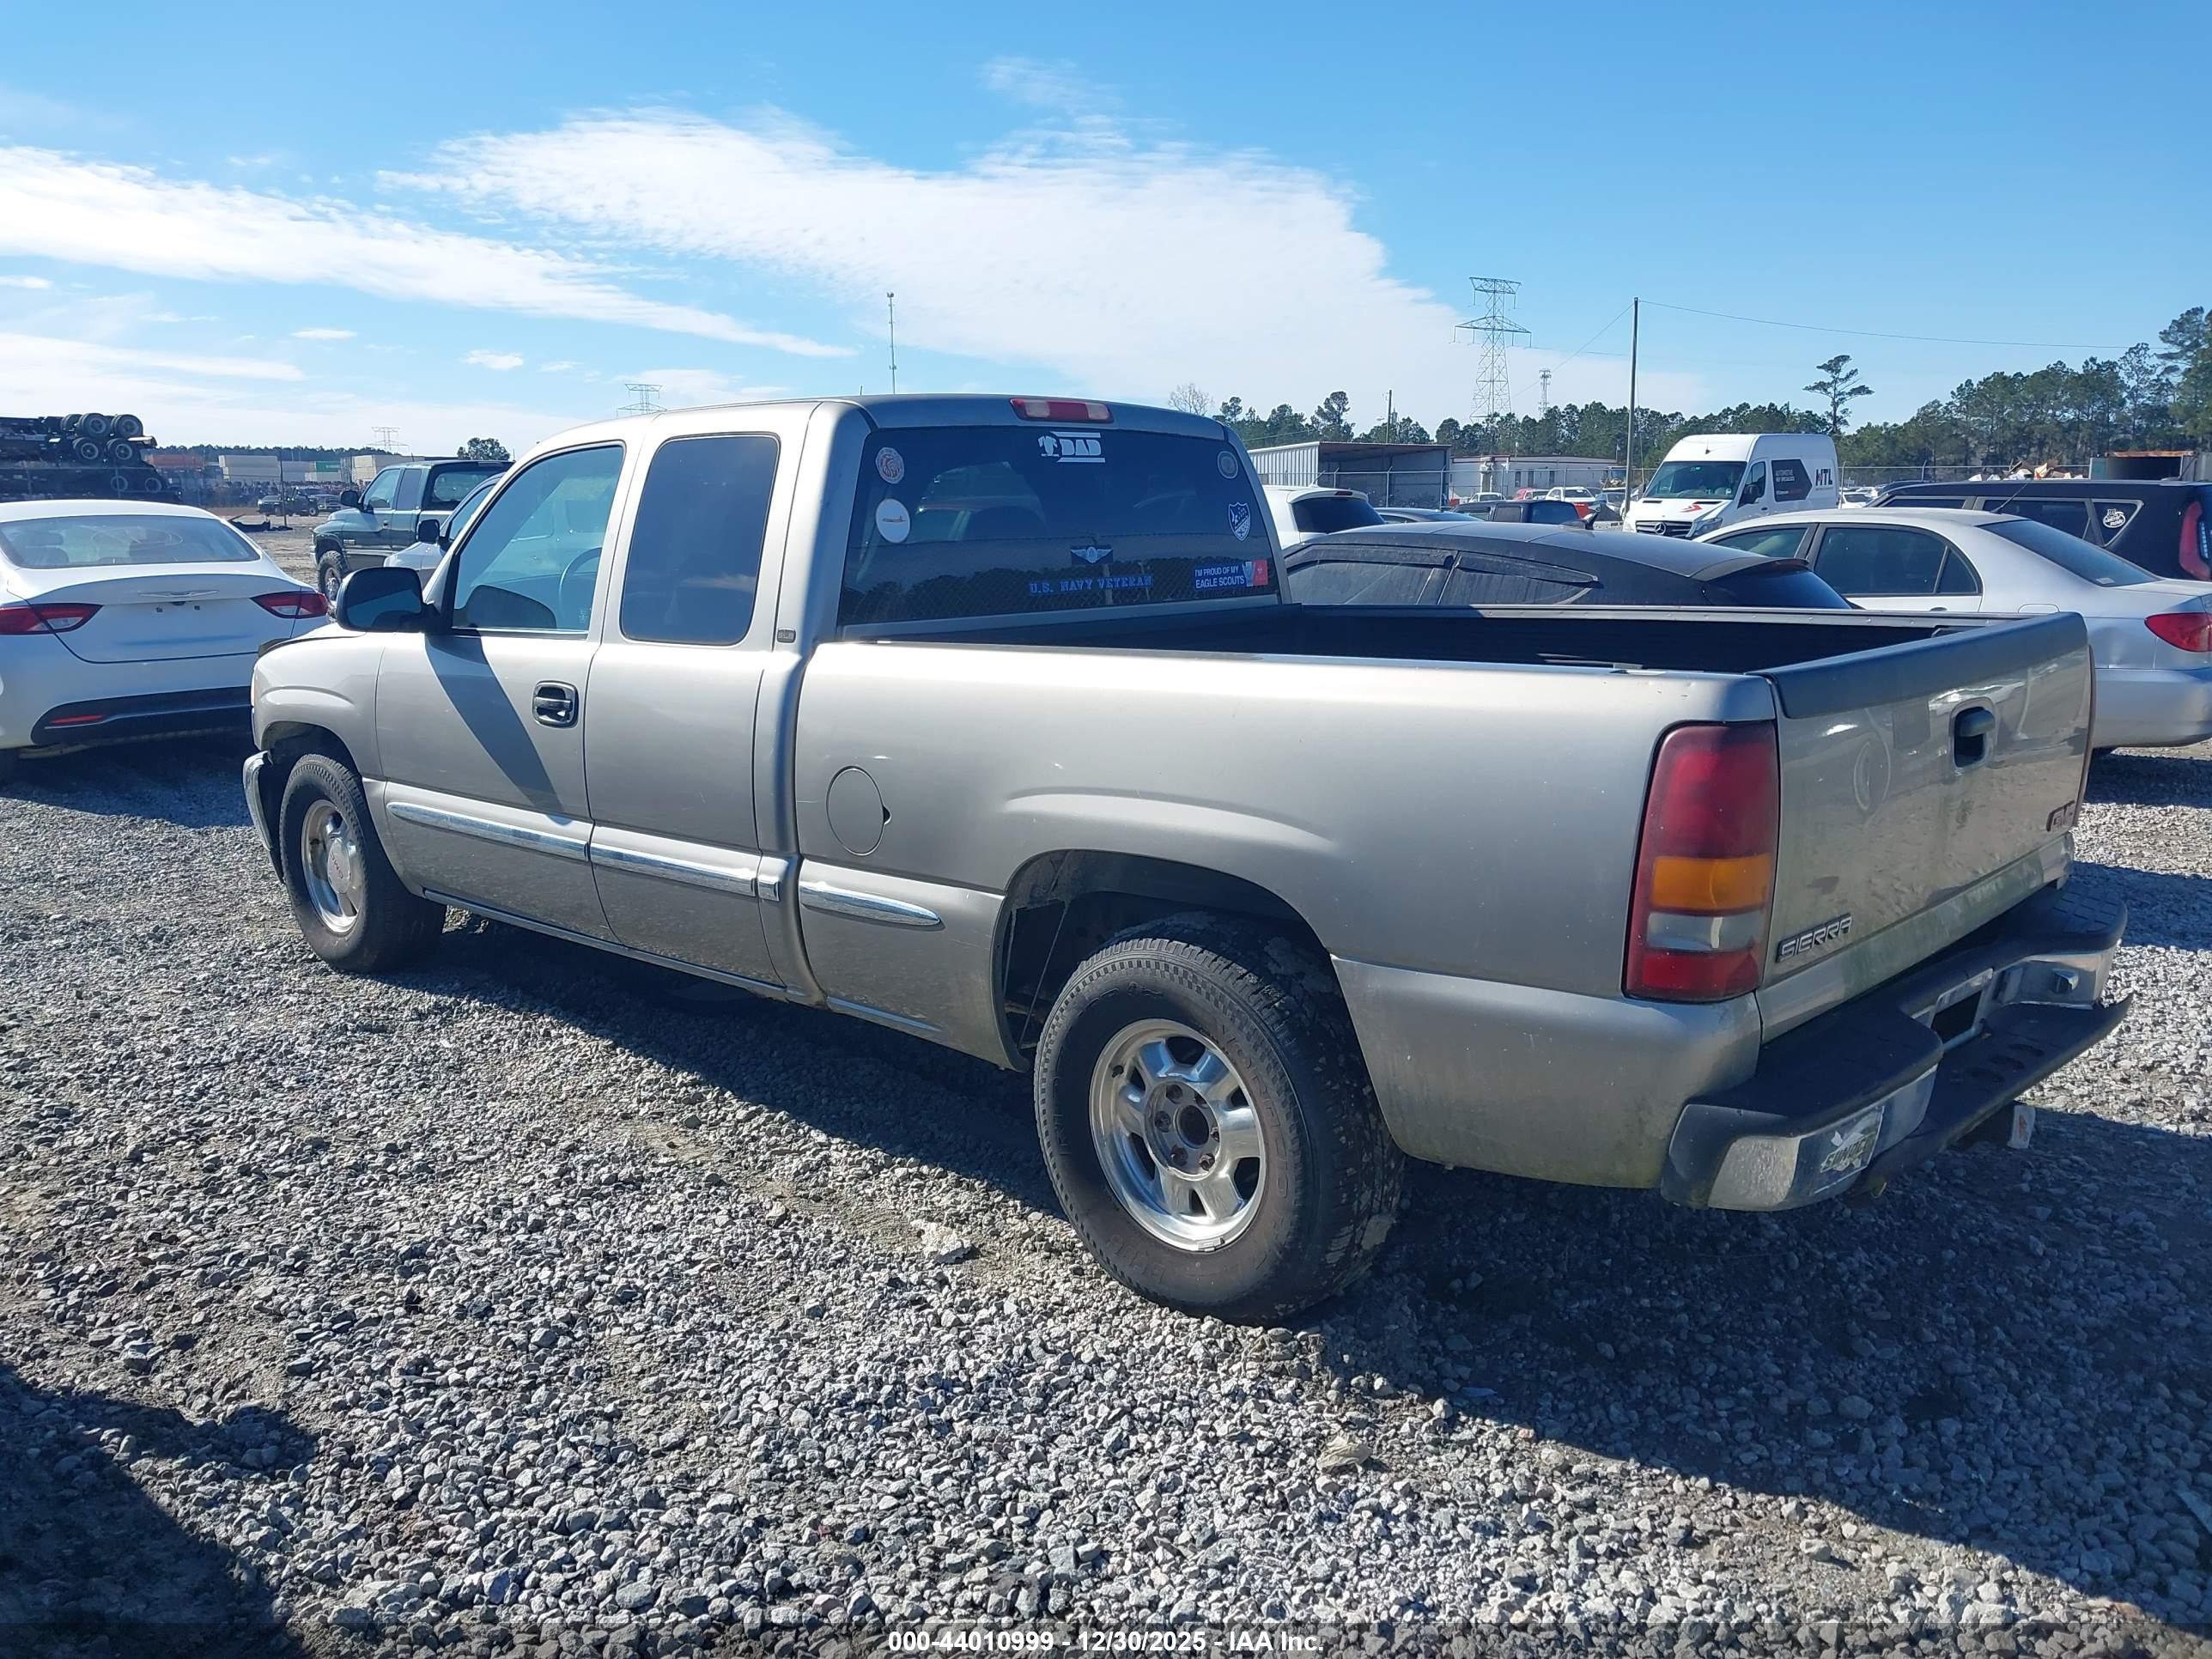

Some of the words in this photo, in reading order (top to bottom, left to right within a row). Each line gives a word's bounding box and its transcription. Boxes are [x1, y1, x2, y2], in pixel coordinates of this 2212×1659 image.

[1203, 567, 1222, 577] PROUD
[1222, 566, 1231, 574] OF
[1231, 565, 1239, 574] MY
[1030, 582, 1054, 594] U.S.
[1059, 578, 1093, 592] NAVY
[1097, 574, 1152, 590] VETERAN
[1195, 577, 1218, 589] EAGLE
[1218, 575, 1245, 586] SCOUTS
[1780, 915, 1852, 962] SIERRA
